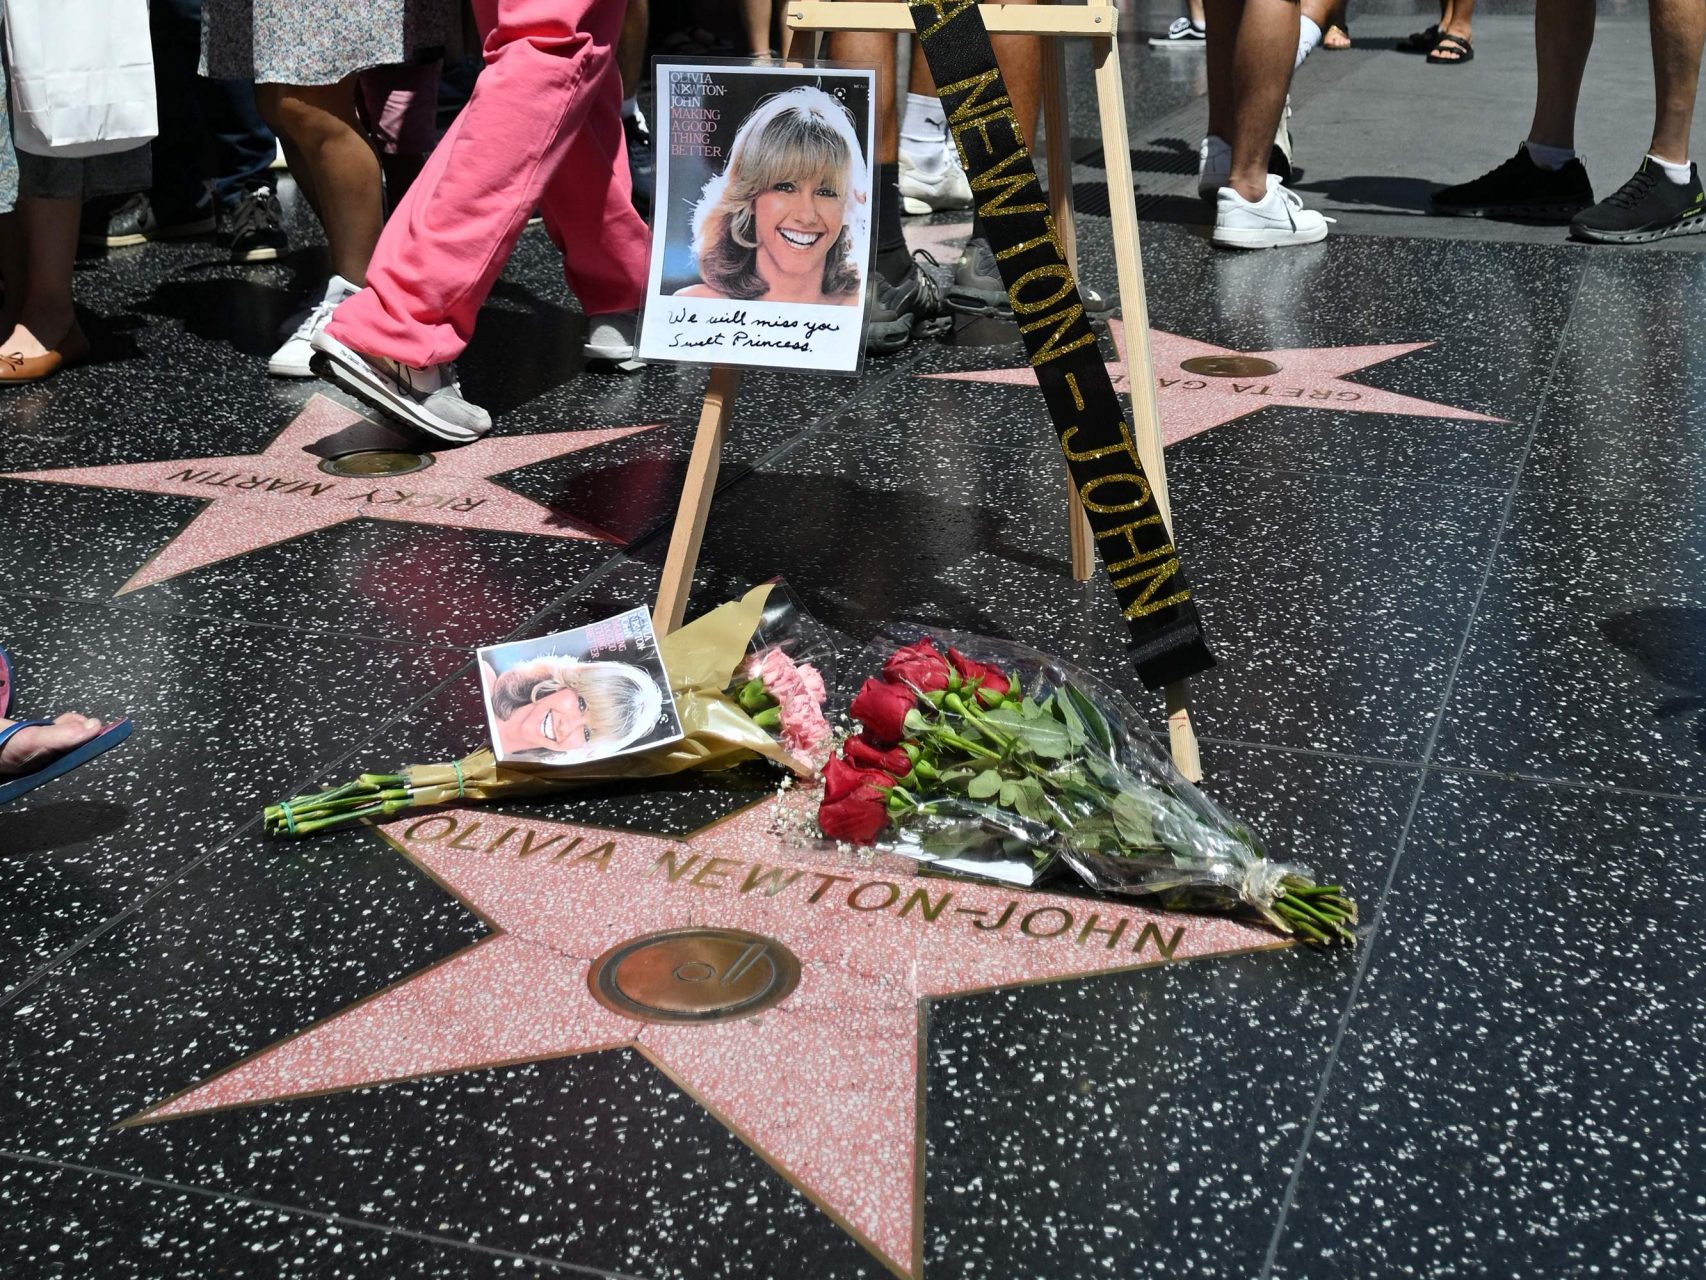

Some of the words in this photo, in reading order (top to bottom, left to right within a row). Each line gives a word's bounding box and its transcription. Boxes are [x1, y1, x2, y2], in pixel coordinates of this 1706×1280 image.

[670, 72, 713, 84] OLIVIA
[670, 95, 701, 109] JOHN
[671, 108, 720, 120] MAKING
[671, 120, 681, 131] A
[682, 121, 717, 132] GOOD
[671, 132, 710, 144] THING
[671, 144, 721, 157] BETTER
[668, 308, 698, 324] We
[706, 310, 747, 326] will
[751, 316, 798, 328] miss
[803, 321, 840, 339] you
[936, 67, 1191, 621] NEWTON-JOHN
[1231, 382, 1362, 402] GRETA
[166, 468, 336, 497] MARTIN
[348, 488, 487, 513] RICKY
[402, 814, 618, 871] OLIVIA
[645, 848, 1187, 961] NEWTON-JOHN
